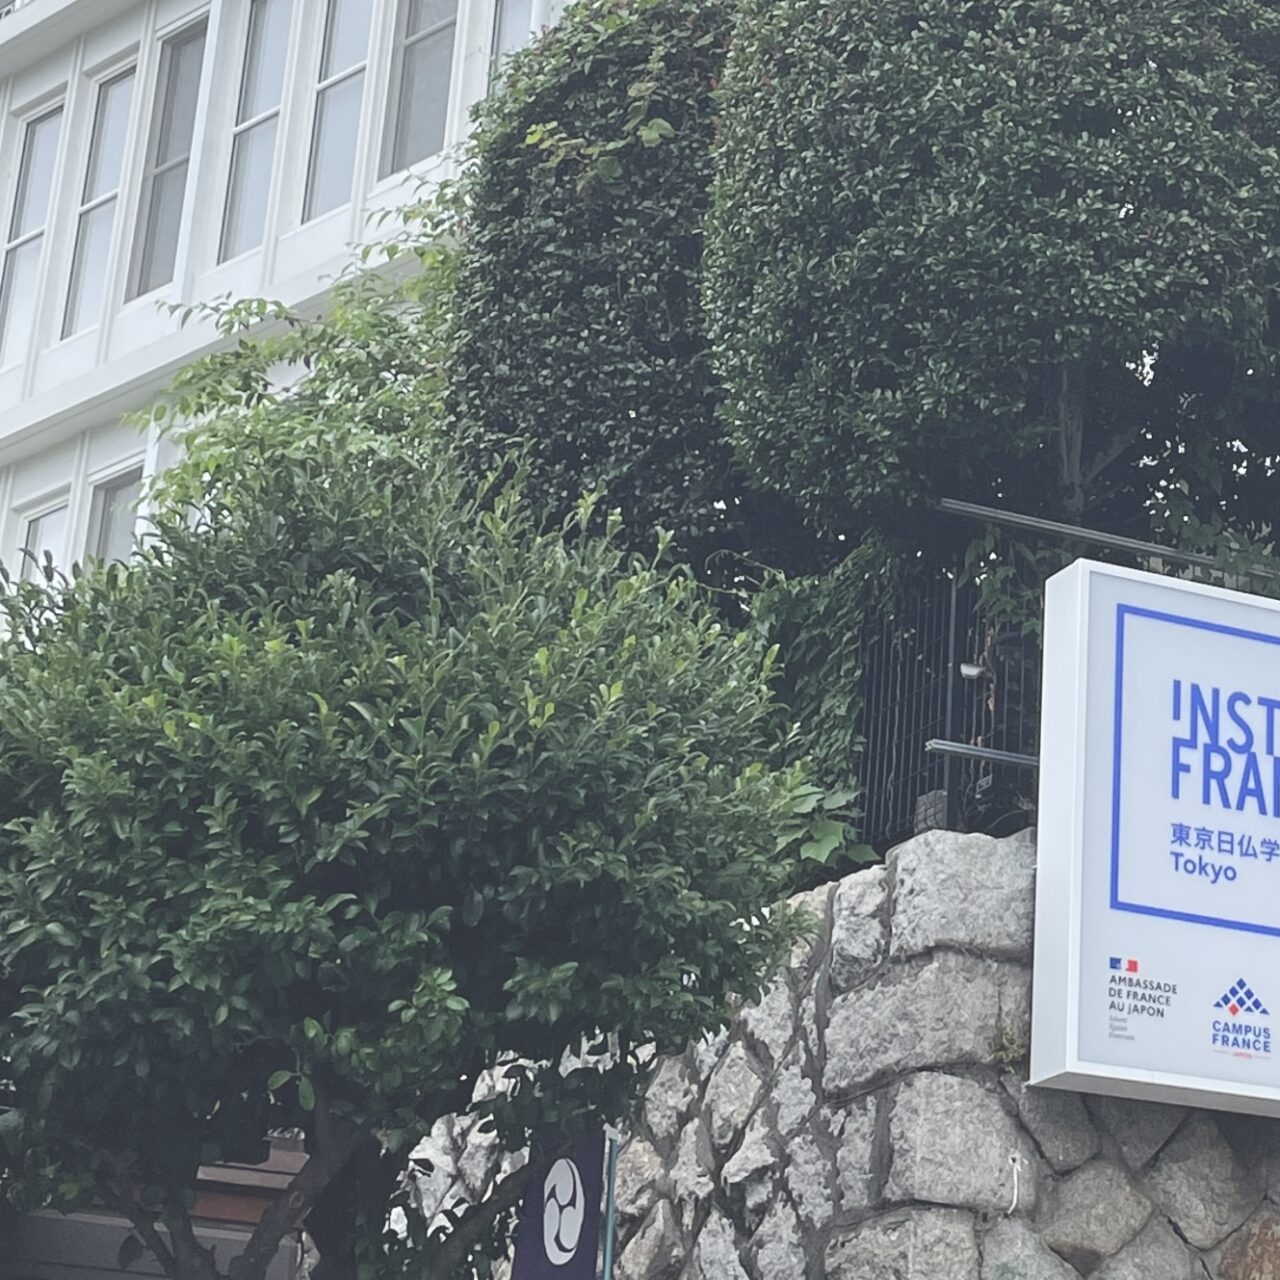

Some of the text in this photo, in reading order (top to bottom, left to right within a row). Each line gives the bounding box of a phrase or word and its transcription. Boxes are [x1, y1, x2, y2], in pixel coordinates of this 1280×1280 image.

[1170, 851, 1237, 884] Tokyo
[1109, 974, 1178, 995] AMBASSADE
[1108, 986, 1171, 1007] DE FRANCE
[1108, 999, 1165, 1018] AU JAPON
[1212, 1020, 1271, 1040] CAMPUS
[1212, 1033, 1271, 1053] FRANCE
